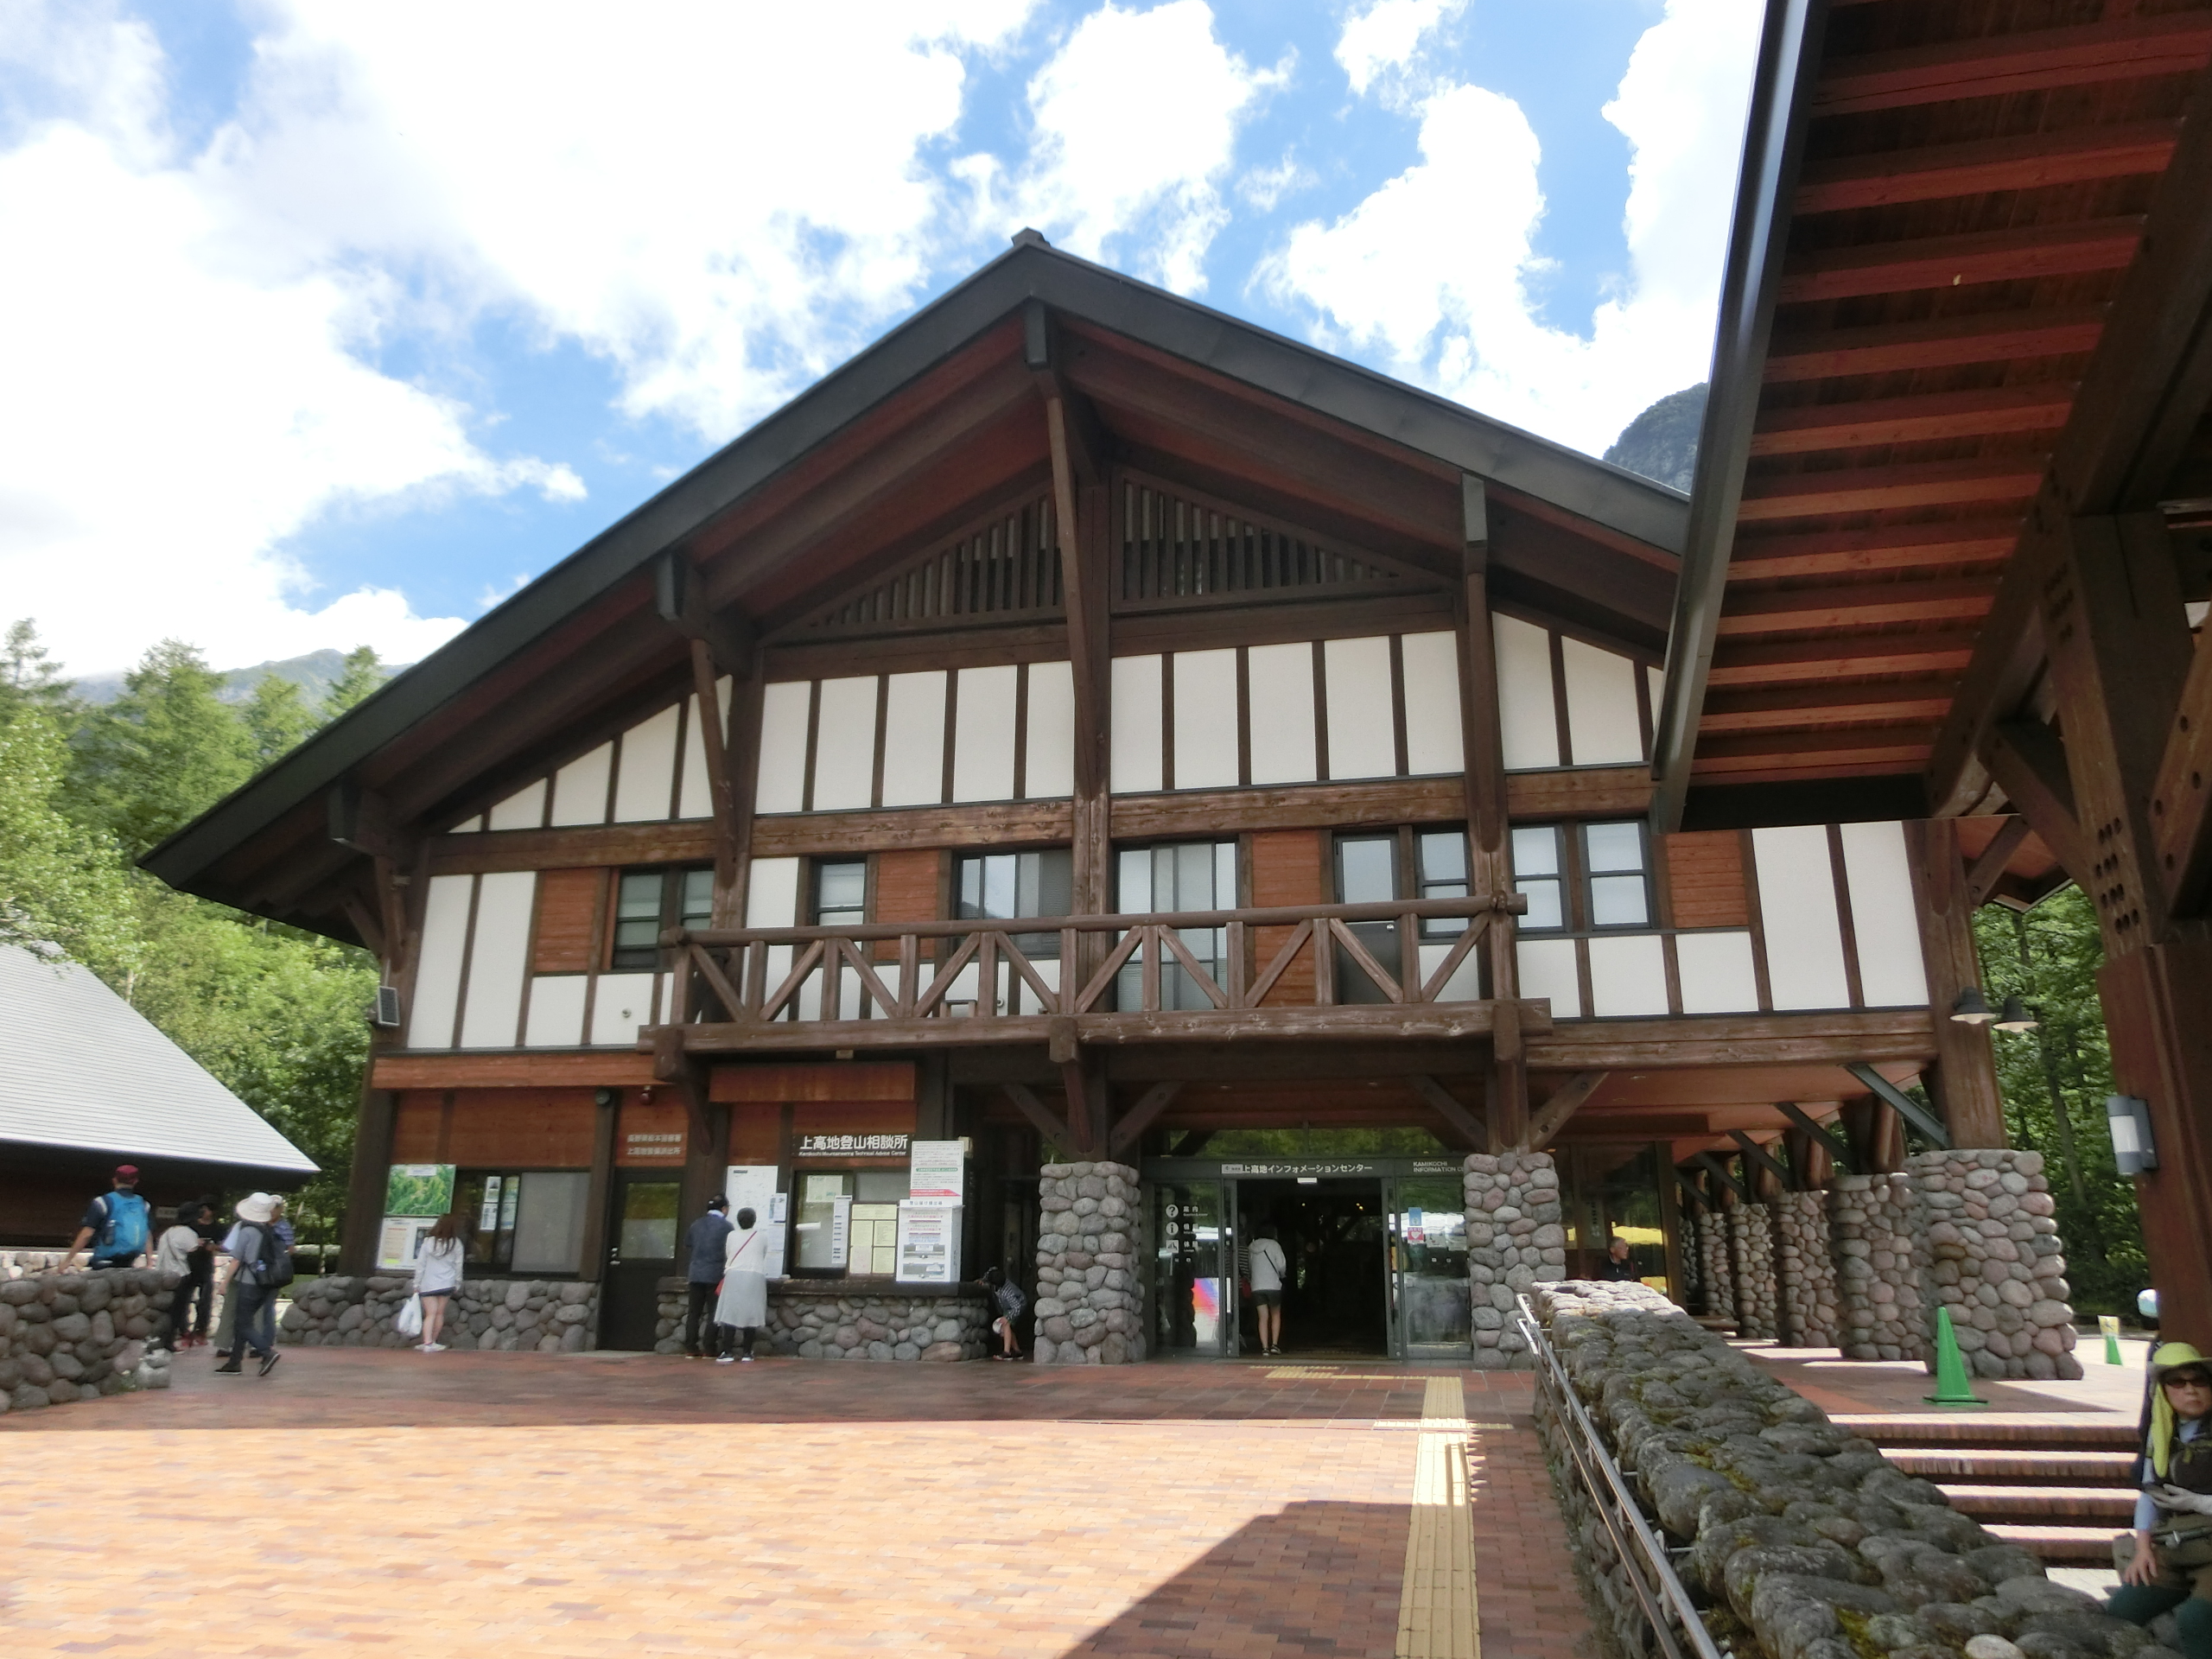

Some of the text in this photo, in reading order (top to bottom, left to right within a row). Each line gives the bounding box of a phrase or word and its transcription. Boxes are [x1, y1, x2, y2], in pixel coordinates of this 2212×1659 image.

[799, 1135, 908, 1150] 上高地登山相談所
[1243, 1164, 1373, 1174] 上高地インフォメーションセンター
